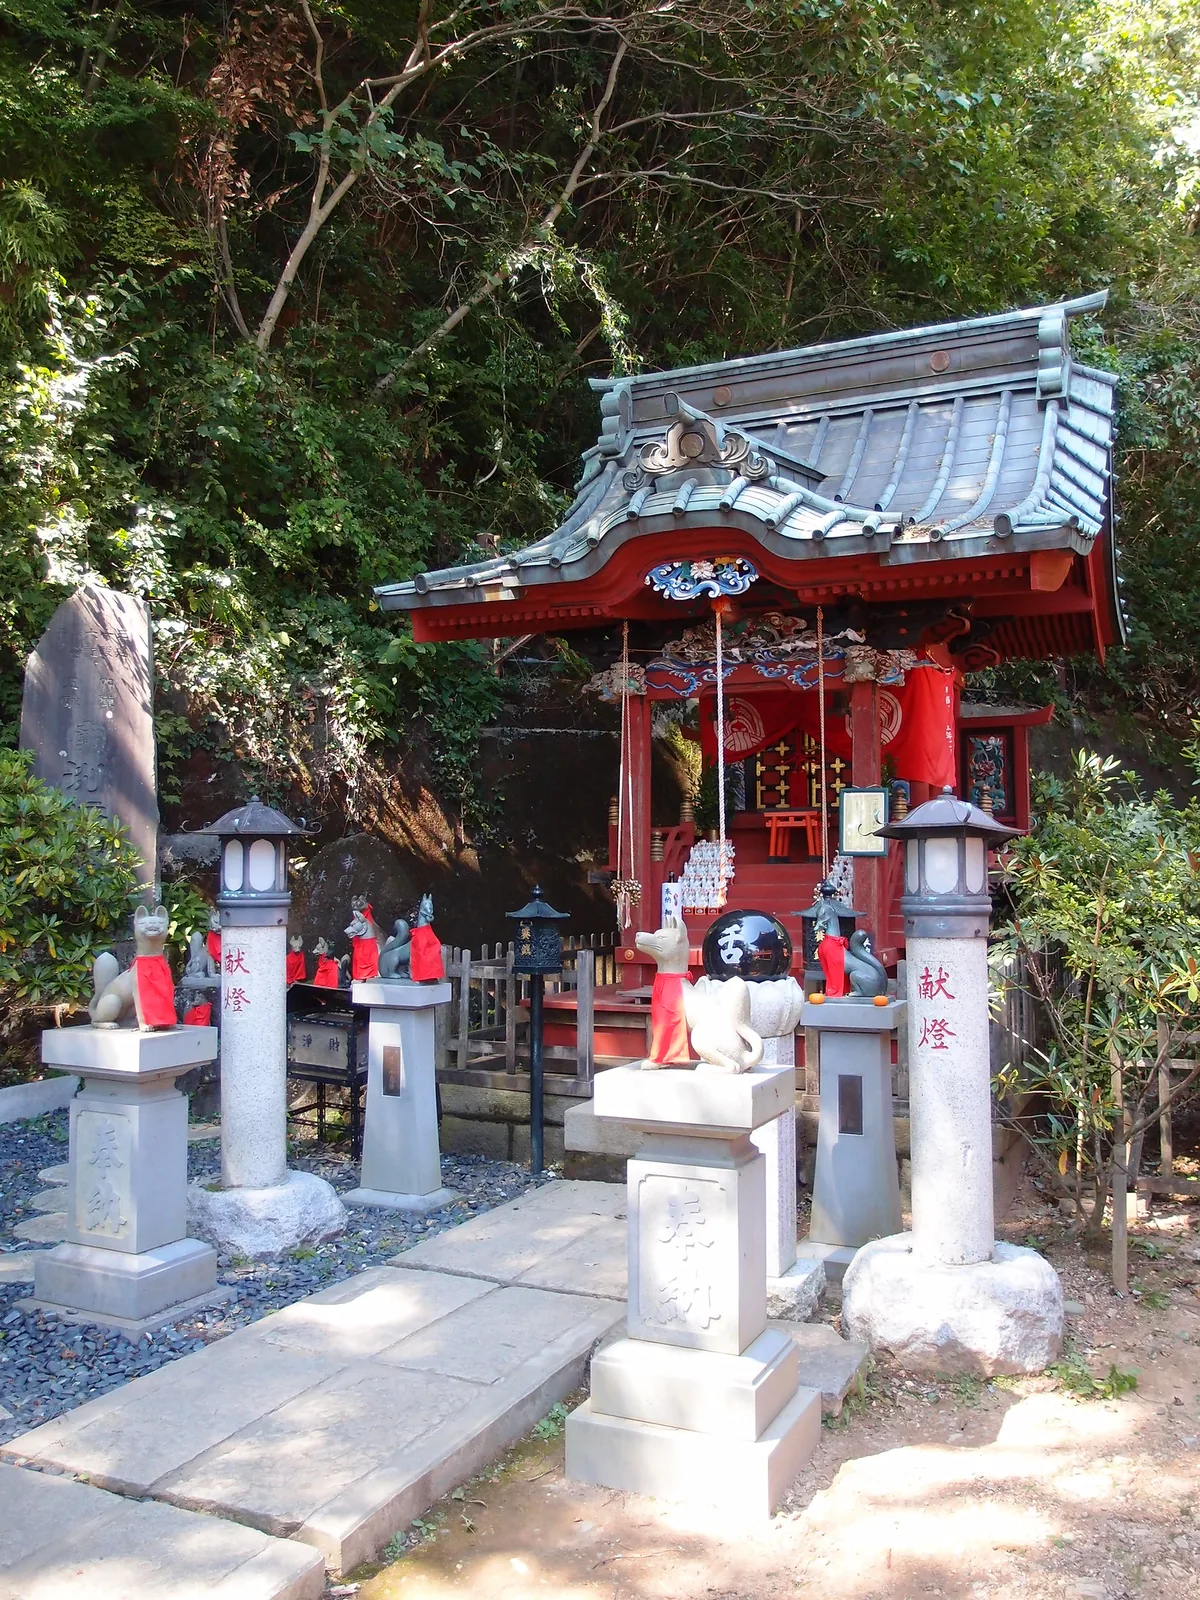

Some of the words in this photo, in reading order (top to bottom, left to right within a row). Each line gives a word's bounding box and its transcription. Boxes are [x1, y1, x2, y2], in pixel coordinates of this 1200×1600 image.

[224, 947, 251, 1012] 献燈
[917, 966, 957, 1050] 献燈
[87, 1120, 128, 1236] 奉納
[657, 1184, 722, 1331] 奉納
